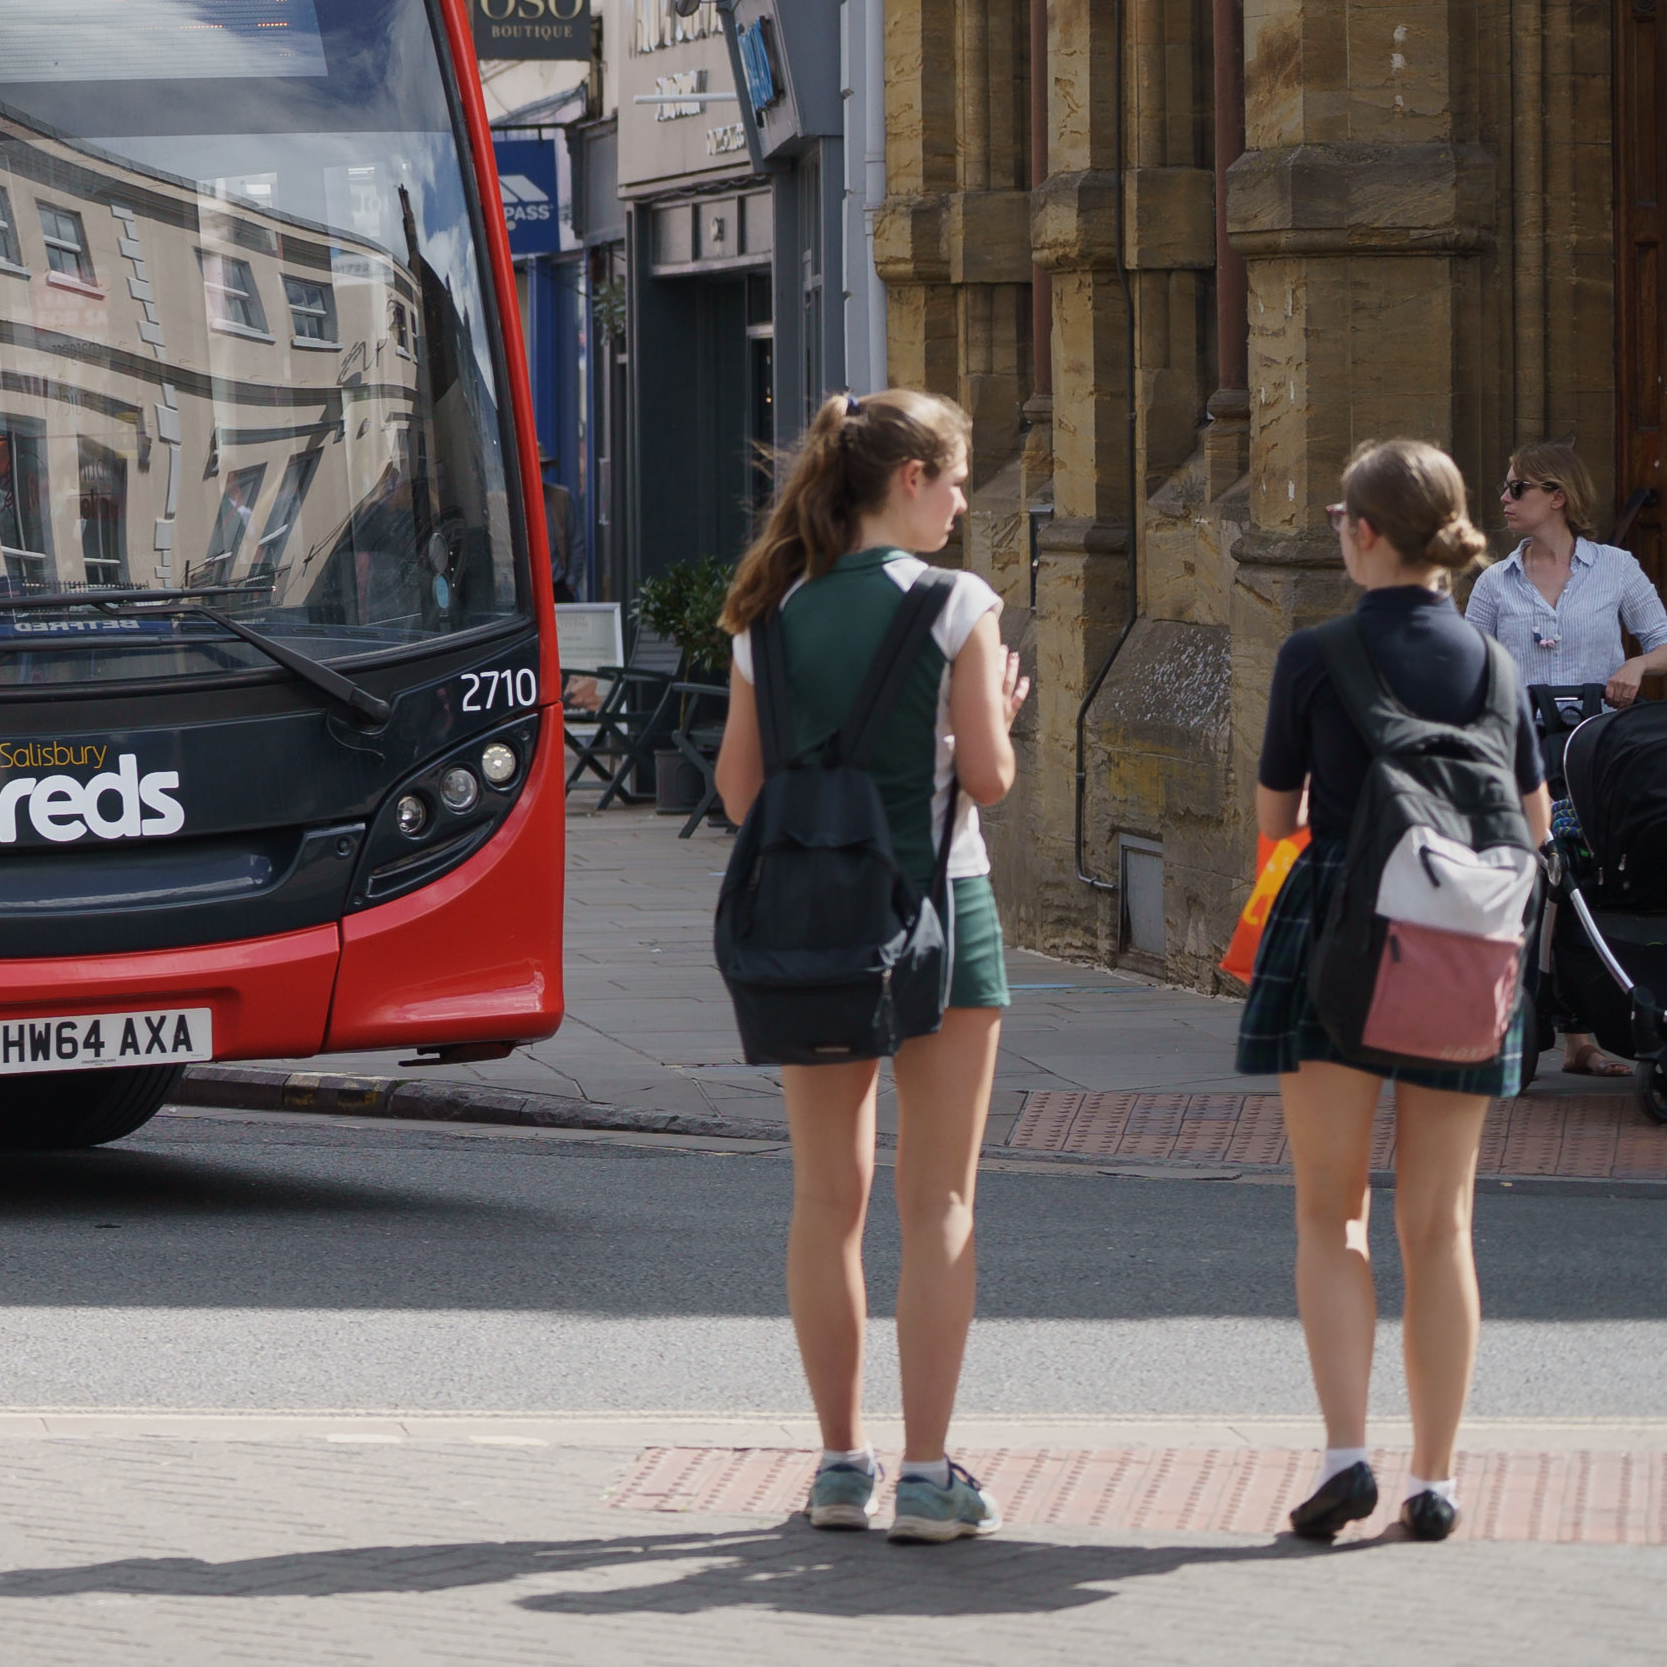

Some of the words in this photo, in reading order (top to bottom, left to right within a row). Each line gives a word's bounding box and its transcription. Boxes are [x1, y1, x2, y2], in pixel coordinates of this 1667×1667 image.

[491, 24, 573, 41] BOUTIQUE
[504, 204, 550, 221] PASS
[461, 668, 537, 712] 2710
[0, 741, 106, 770] Salisbury
[3, 1020, 105, 1064] HW64
[119, 1014, 194, 1057] AXA
